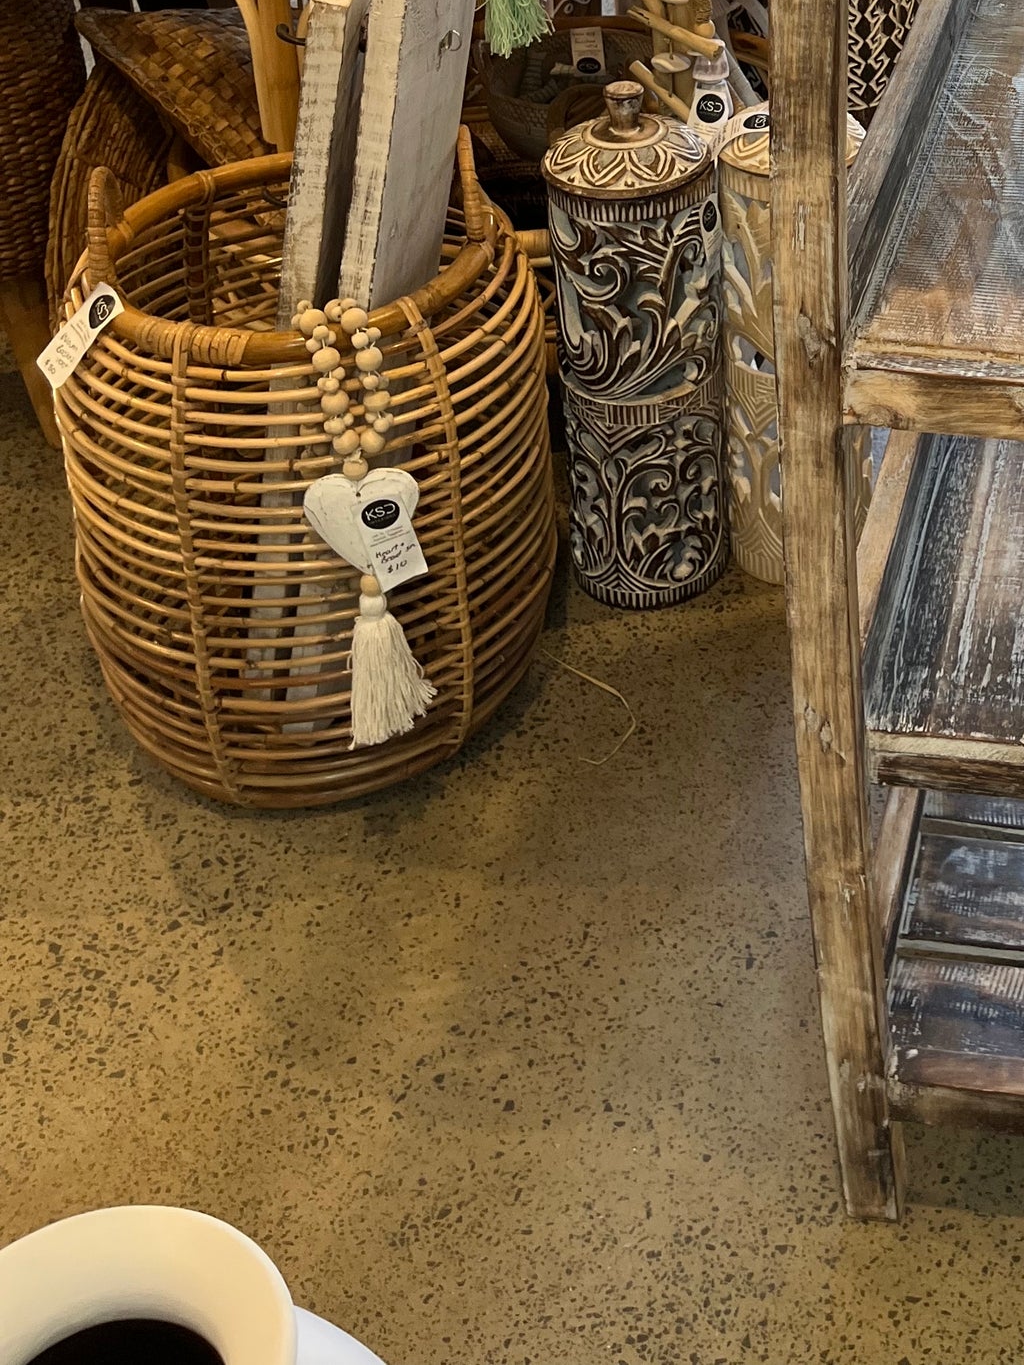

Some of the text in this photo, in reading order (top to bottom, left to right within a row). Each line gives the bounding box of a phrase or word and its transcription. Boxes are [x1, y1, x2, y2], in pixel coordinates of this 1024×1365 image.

[699, 100, 723, 113] KSD
[95, 297, 110, 321] KSD
[365, 503, 396, 521] KSD
[386, 559, 408, 574] $10
